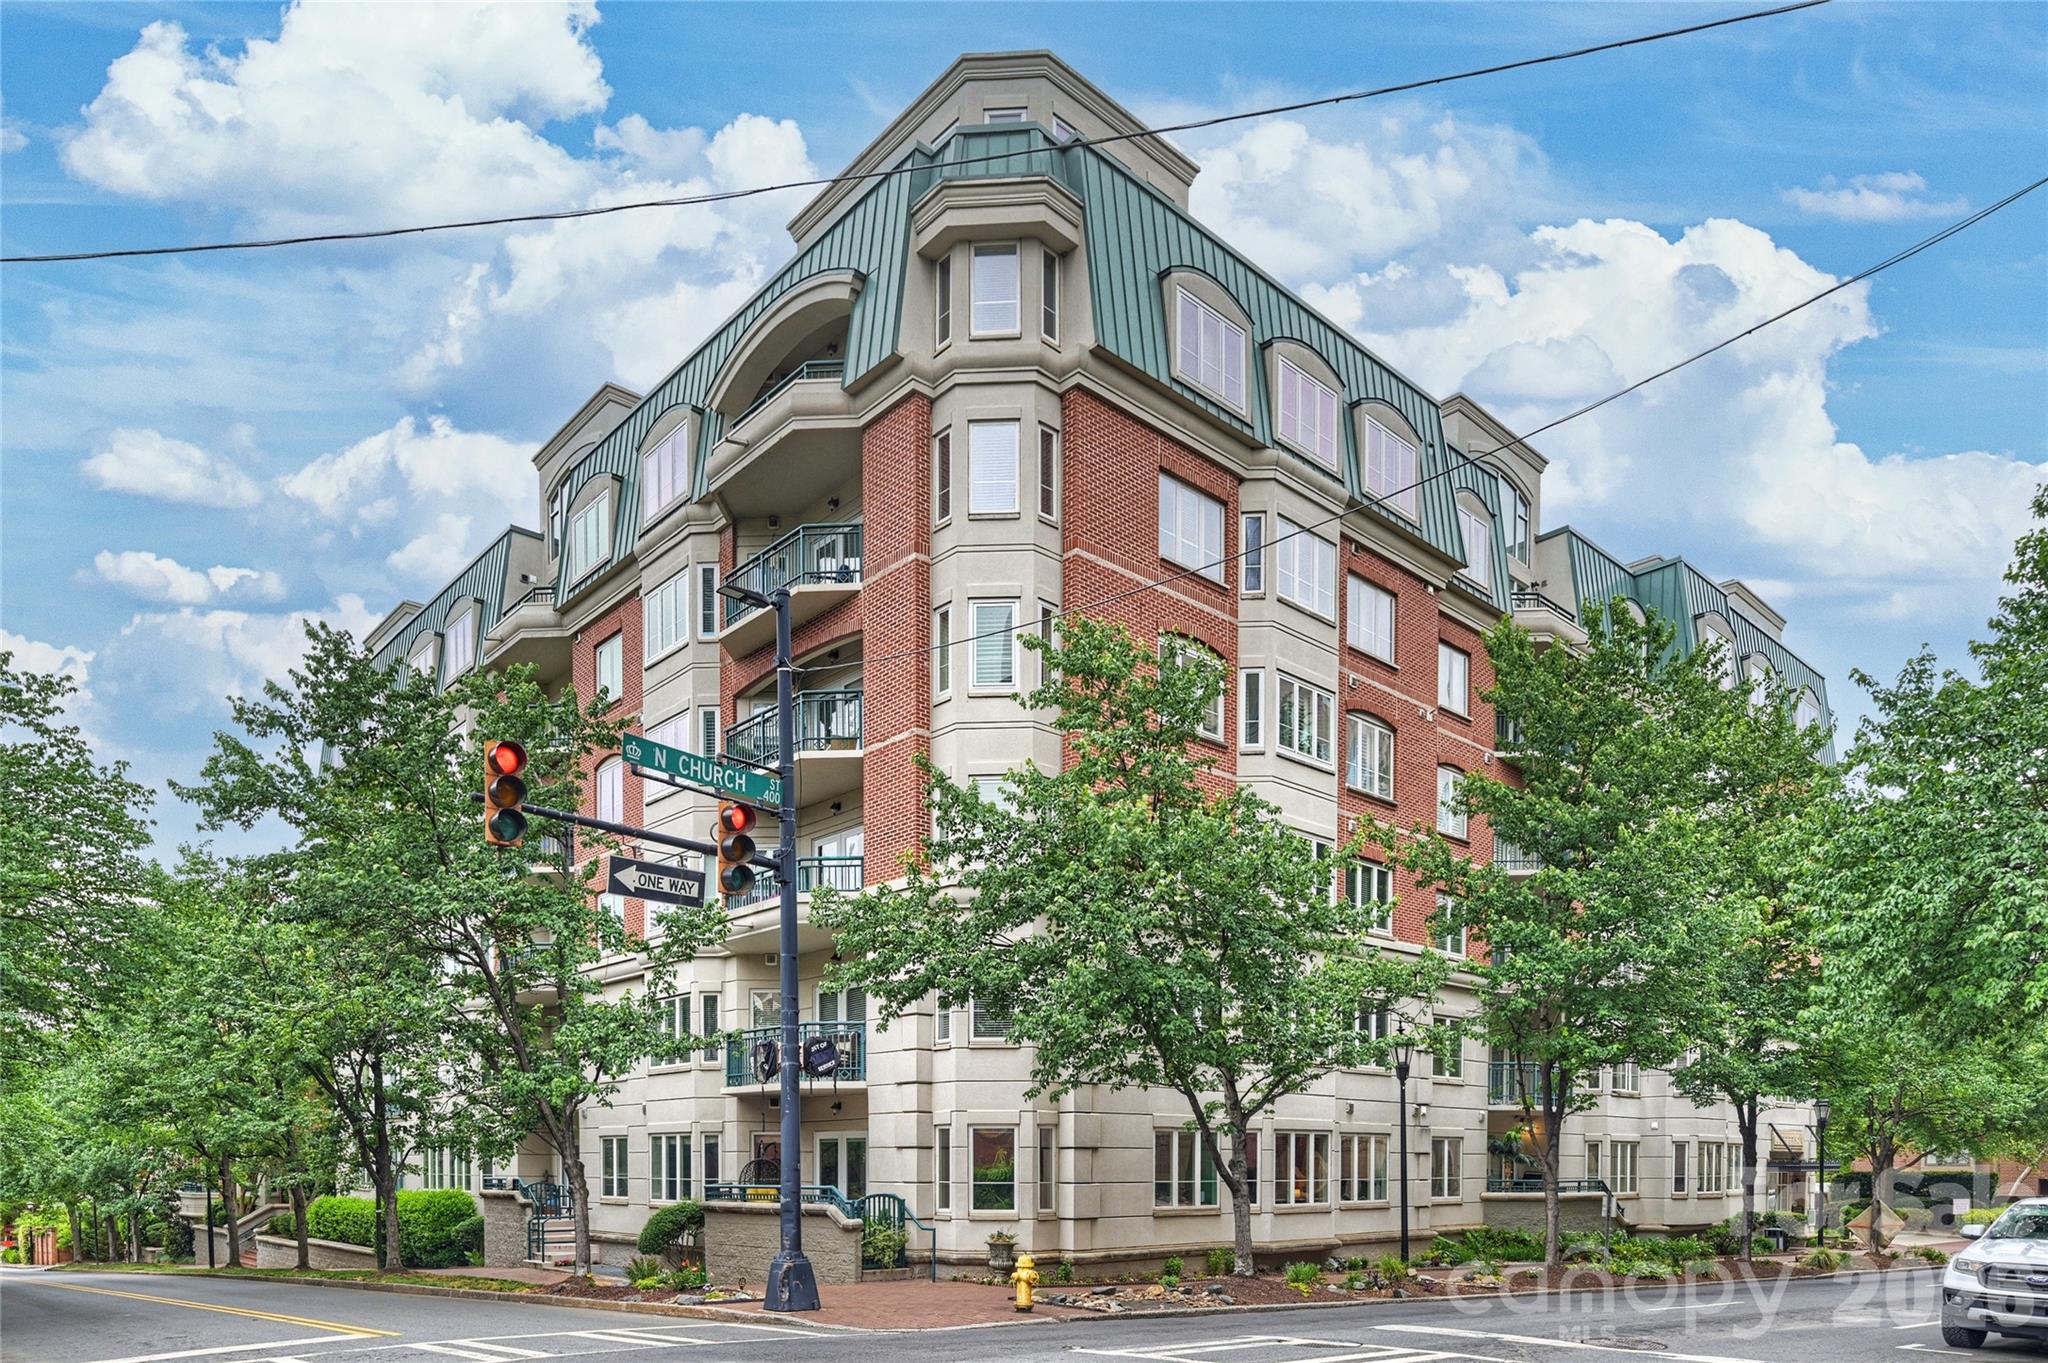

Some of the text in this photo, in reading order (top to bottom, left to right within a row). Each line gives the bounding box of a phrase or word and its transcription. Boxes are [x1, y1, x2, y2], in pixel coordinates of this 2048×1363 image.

[655, 747, 746, 792] N CHURCH
[770, 779, 781, 791] ST
[763, 790, 781, 804] 400
[638, 873, 696, 895] ONE WAY
